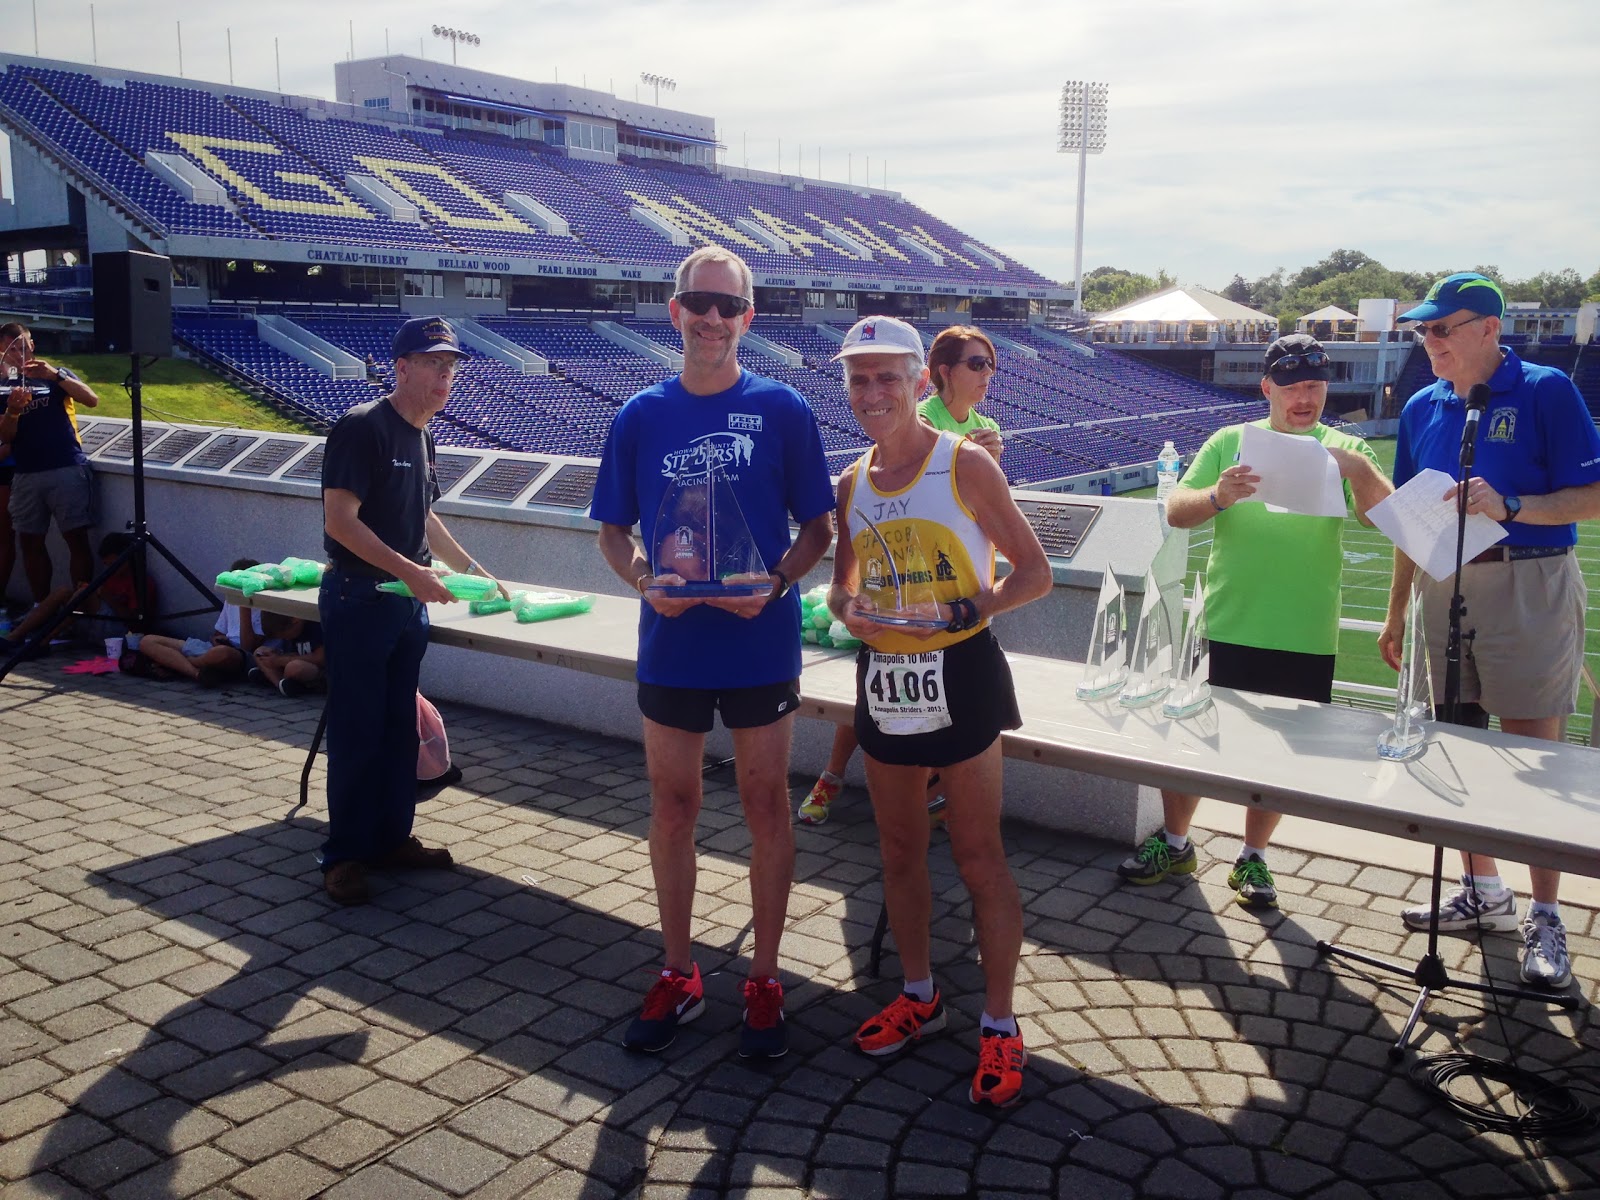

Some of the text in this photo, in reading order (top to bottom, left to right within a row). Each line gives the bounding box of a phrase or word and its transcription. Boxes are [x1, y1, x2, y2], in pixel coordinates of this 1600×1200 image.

[165, 131, 980, 270] GO NAVY
[307, 249, 409, 266] CHATEAU-THIERRY
[438, 258, 511, 272] BELLEAU WOOD
[538, 264, 598, 276] PEARL HARBOR
[621, 269, 642, 279] WAKE
[764, 278, 796, 286] ALEUTIANS
[811, 280, 832, 288] MIDWAY
[848, 282, 881, 290] GUADALCANAL
[732, 416, 759, 424] FEET
[731, 422, 761, 430] FIRST
[873, 498, 911, 520] JAY
[873, 652, 938, 665] Annapolis 10 Mile
[870, 669, 939, 703] 4106
[874, 705, 899, 713] Annapolis
[927, 705, 942, 713] 2013
